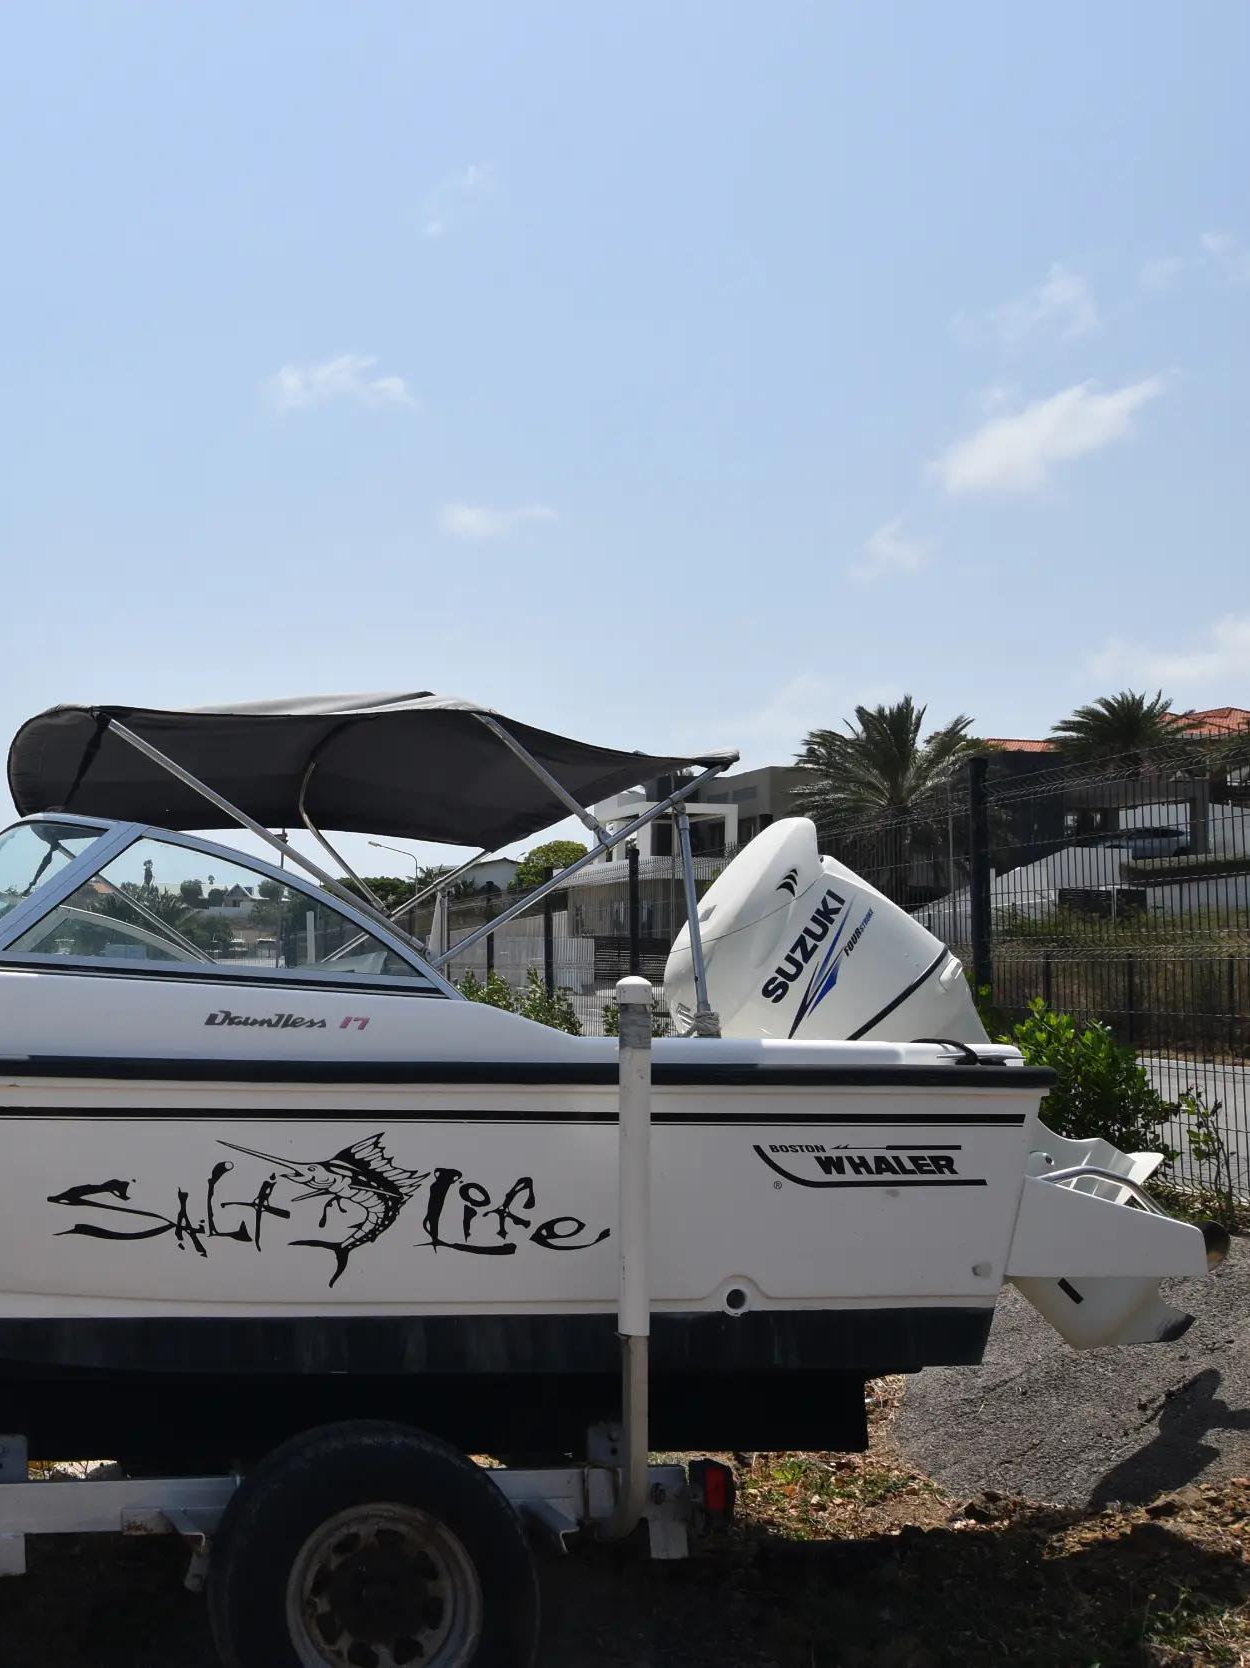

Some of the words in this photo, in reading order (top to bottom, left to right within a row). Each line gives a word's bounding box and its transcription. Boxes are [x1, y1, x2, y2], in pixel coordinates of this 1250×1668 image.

[762, 889, 846, 1004] SUZUKI
[205, 1010, 327, 1029] Dauntless
[339, 1016, 370, 1030] 17
[768, 1144, 827, 1153] BOSTON
[814, 1155, 959, 1175] WHALER
[413, 1168, 611, 1255] Life
